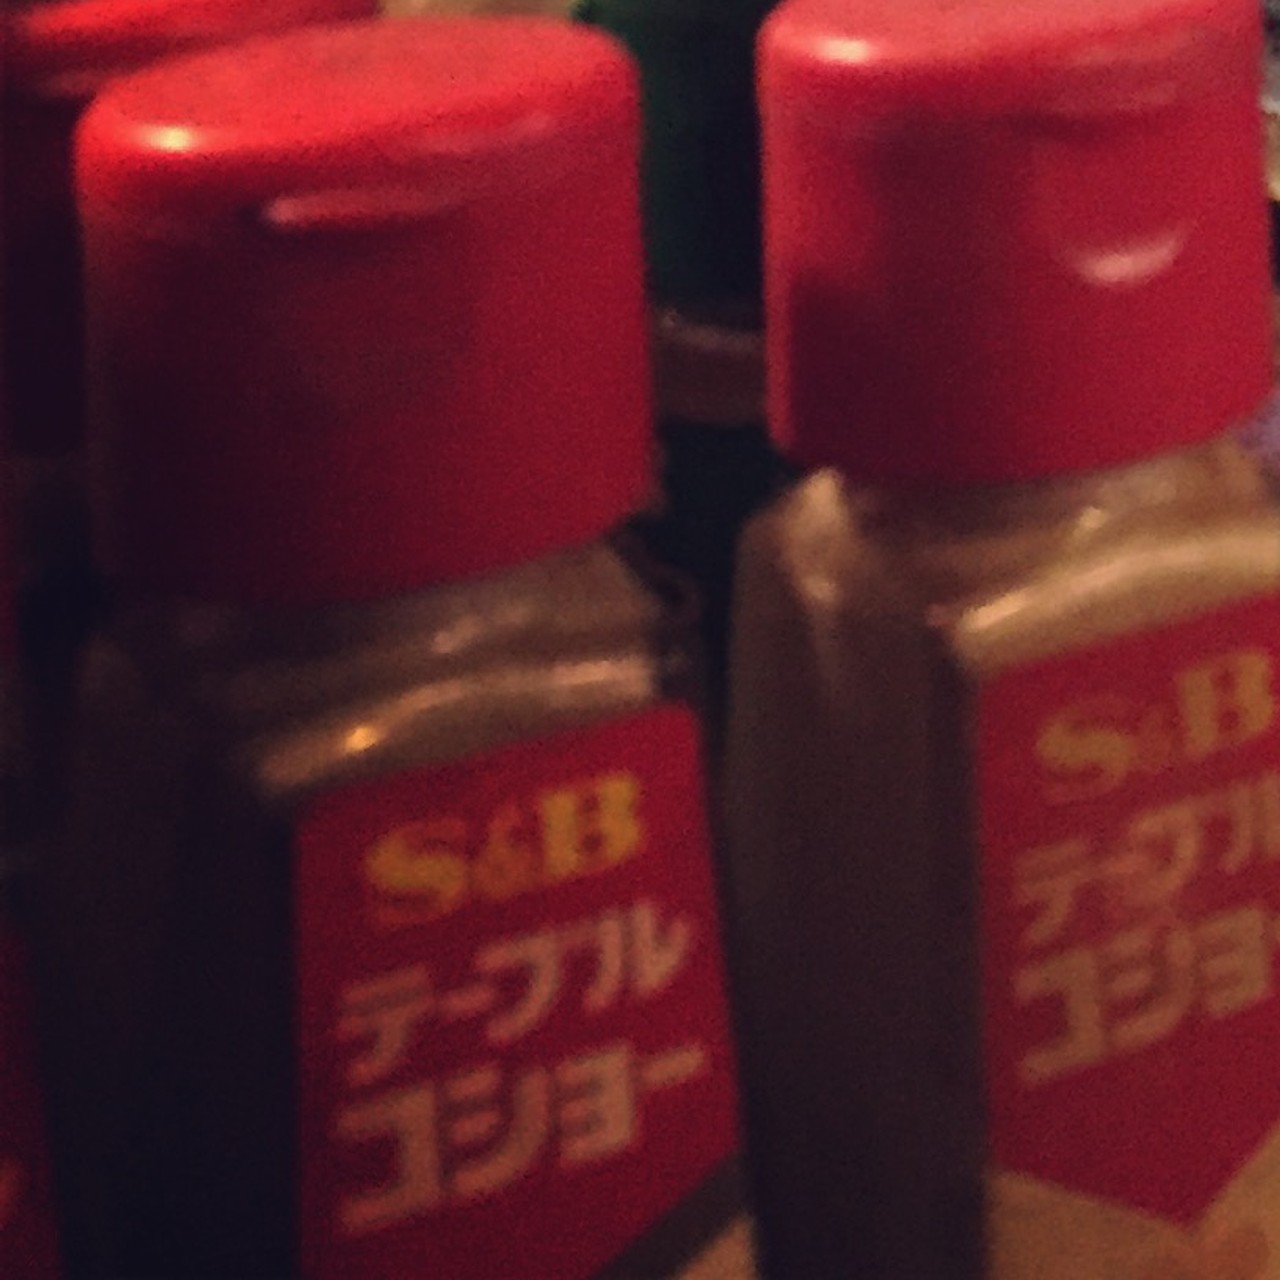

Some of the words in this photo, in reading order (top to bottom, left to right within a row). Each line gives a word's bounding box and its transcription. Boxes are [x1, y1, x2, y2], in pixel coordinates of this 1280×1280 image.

[364, 771, 643, 930] S&B
[336, 1040, 707, 1233] コショー
